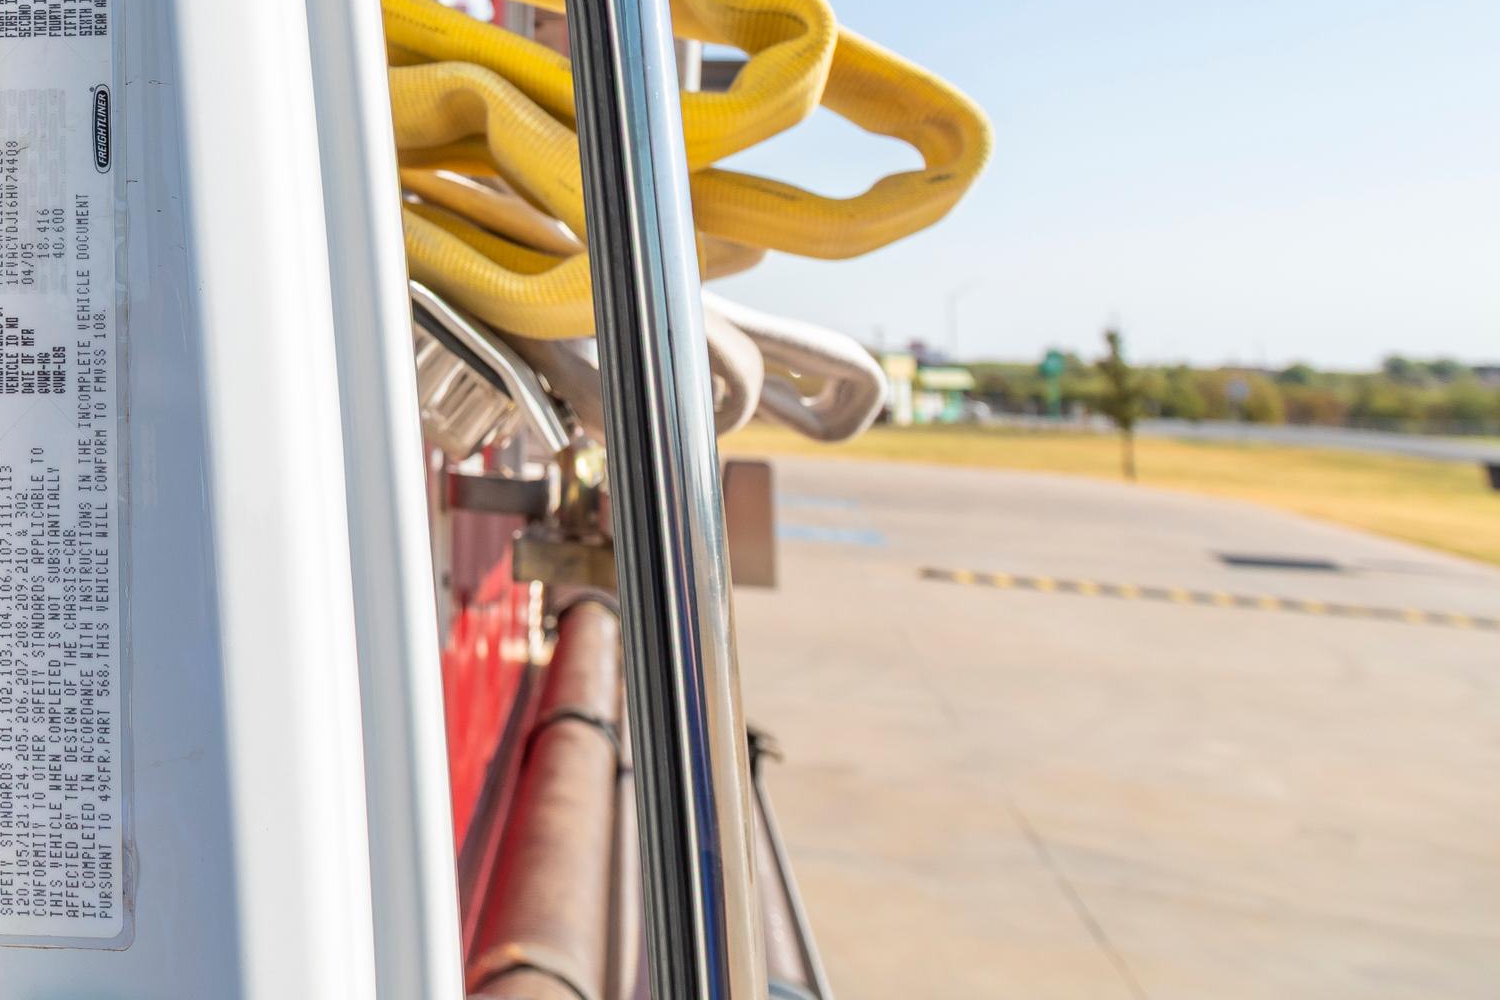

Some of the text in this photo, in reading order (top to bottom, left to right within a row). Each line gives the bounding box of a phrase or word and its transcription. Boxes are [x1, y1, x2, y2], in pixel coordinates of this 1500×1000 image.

[5, 10, 18, 38] FIRST
[18, 4, 31, 38] SECOND
[34, 10, 46, 38] THIRD
[48, 4, 62, 38] FOURTH
[64, 9, 76, 37] FIFTH
[79, 8, 92, 36] SIXTH
[94, 13, 107, 36] REAR
[97, 93, 108, 164] FREIGHTLINER
[37, 208, 50, 258] 18,416
[52, 208, 66, 259] 40,600
[22, 242, 34, 285] 04/05
[6, 317, 19, 394] VEHICLE ID NO
[22, 328, 35, 394] DATE OF MFR
[38, 352, 51, 394] GVWR-KG
[53, 346, 66, 394] GVWR-LBS
[94, 349, 106, 392] FMVSS
[94, 402, 107, 420] TO
[94, 430, 107, 492] CONFORM
[95, 503, 108, 538] WILL
[76, 194, 96, 918] IF COMPLETED IN ACCORDANCE WITH INSTRUCTIONS IN THE INCOMPLETE VEHICLE DOCUMENT
[96, 548, 108, 612] VEHICLE
[64, 641, 77, 667] THE
[96, 622, 110, 696] 568,THIS
[31, 448, 47, 916] CONFORMITY TO OTHER SAFETY STANDARDS APPLICABLE TO
[47, 467, 63, 916] THIS VEHICLE WHEN COMPLETED IS NOT SUBSTANTIALLY
[65, 678, 79, 696] OF
[65, 707, 79, 762] DESIGN
[98, 710, 112, 802] 49CFR,PART
[0, 762, 13, 847] STANDARDS
[65, 774, 79, 800] THE
[65, 814, 79, 830] BY
[98, 813, 112, 830] TO
[0, 860, 13, 916] SAFETY
[65, 842, 79, 918] AFFECTED
[98, 844, 112, 919] PURSUANT
